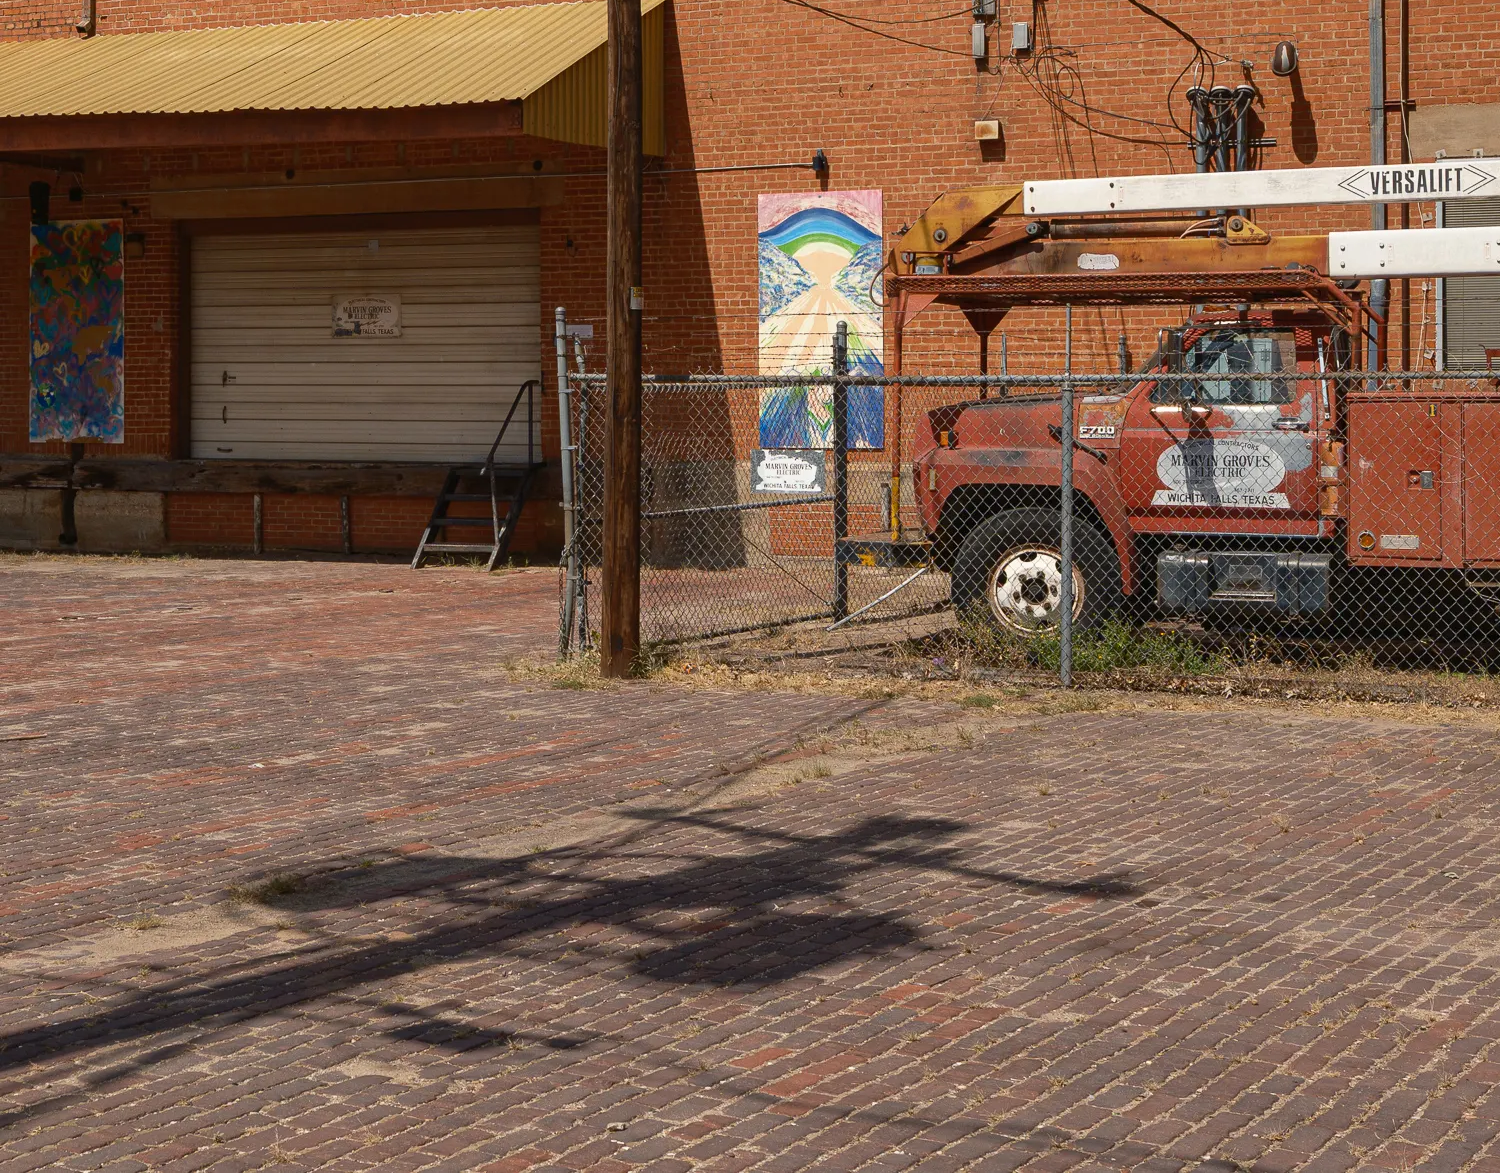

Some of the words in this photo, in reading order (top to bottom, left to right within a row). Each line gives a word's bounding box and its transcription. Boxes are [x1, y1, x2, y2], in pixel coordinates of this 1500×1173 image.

[1370, 167, 1463, 196] VERSALIFT
[343, 306, 367, 314] MARVIN
[368, 306, 392, 314] GROVES
[1429, 404, 1436, 417] 1
[1080, 426, 1115, 434] F700
[1171, 455, 1218, 467] MARVIN
[1223, 455, 1271, 467] GROVES
[1195, 467, 1246, 477] ELECTRIC
[1167, 493, 1206, 503] WICHITA
[1243, 495, 1275, 505] TEXAS
